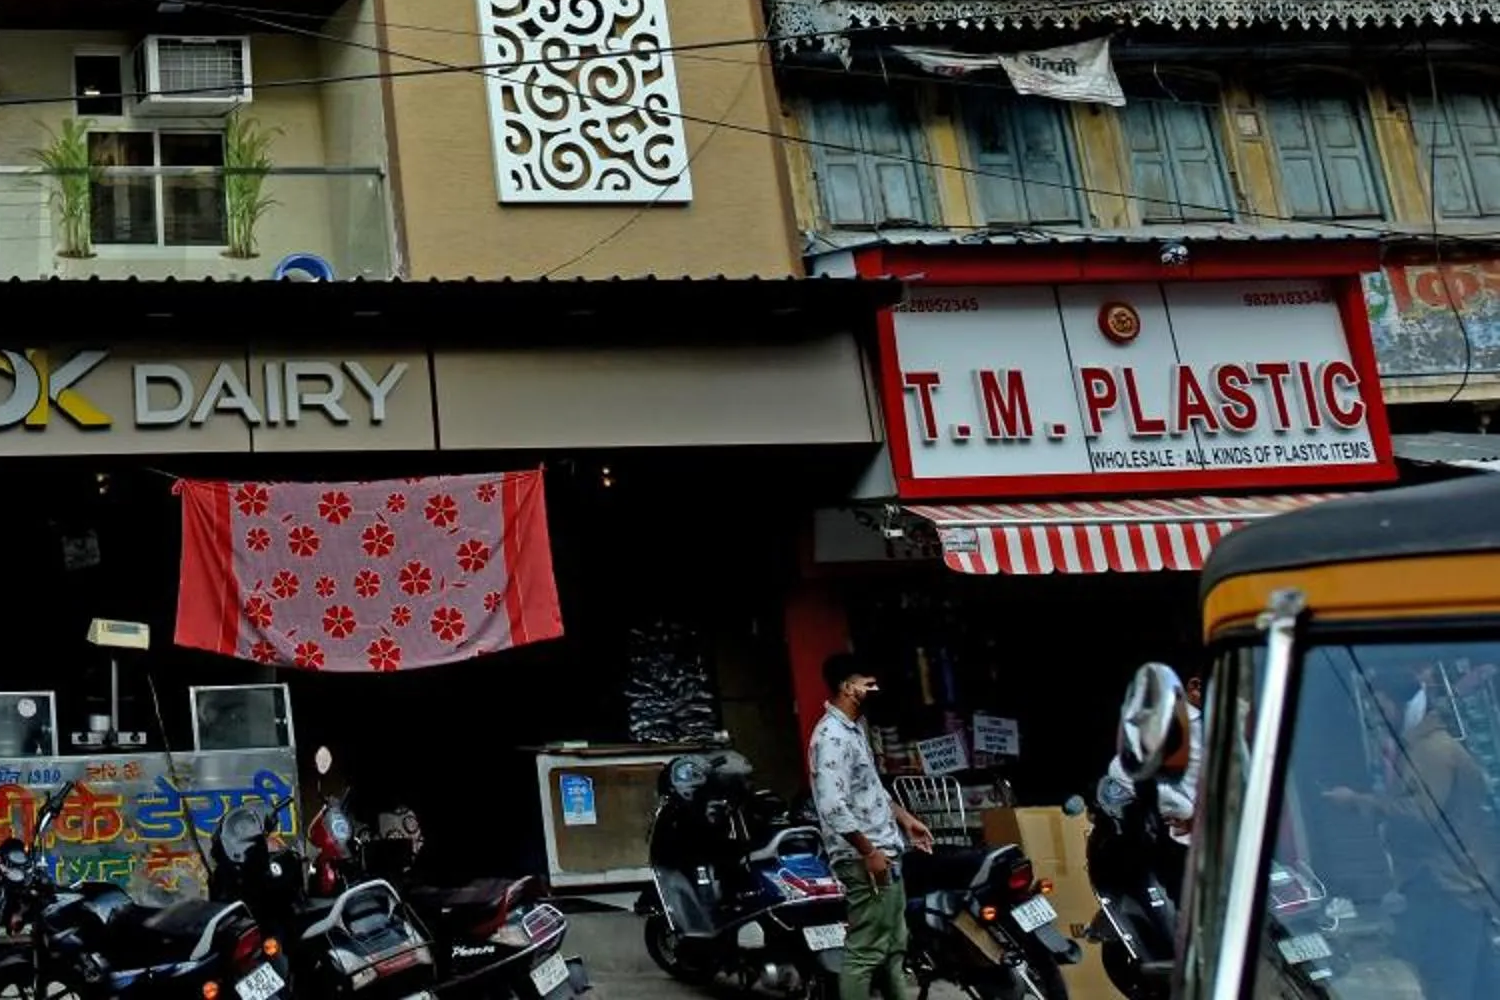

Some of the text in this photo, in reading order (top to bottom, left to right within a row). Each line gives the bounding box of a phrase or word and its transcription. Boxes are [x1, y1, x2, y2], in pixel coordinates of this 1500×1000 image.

[133, 361, 409, 426] DAIRY
[1079, 360, 1368, 440] PLASTIC
[1090, 449, 1176, 469] WHOLESALE
[1211, 446, 1252, 465] KINDS
[1254, 445, 1271, 463] OF
[1273, 443, 1329, 462] PLASTIC
[1330, 441, 1370, 460] ITEMS
